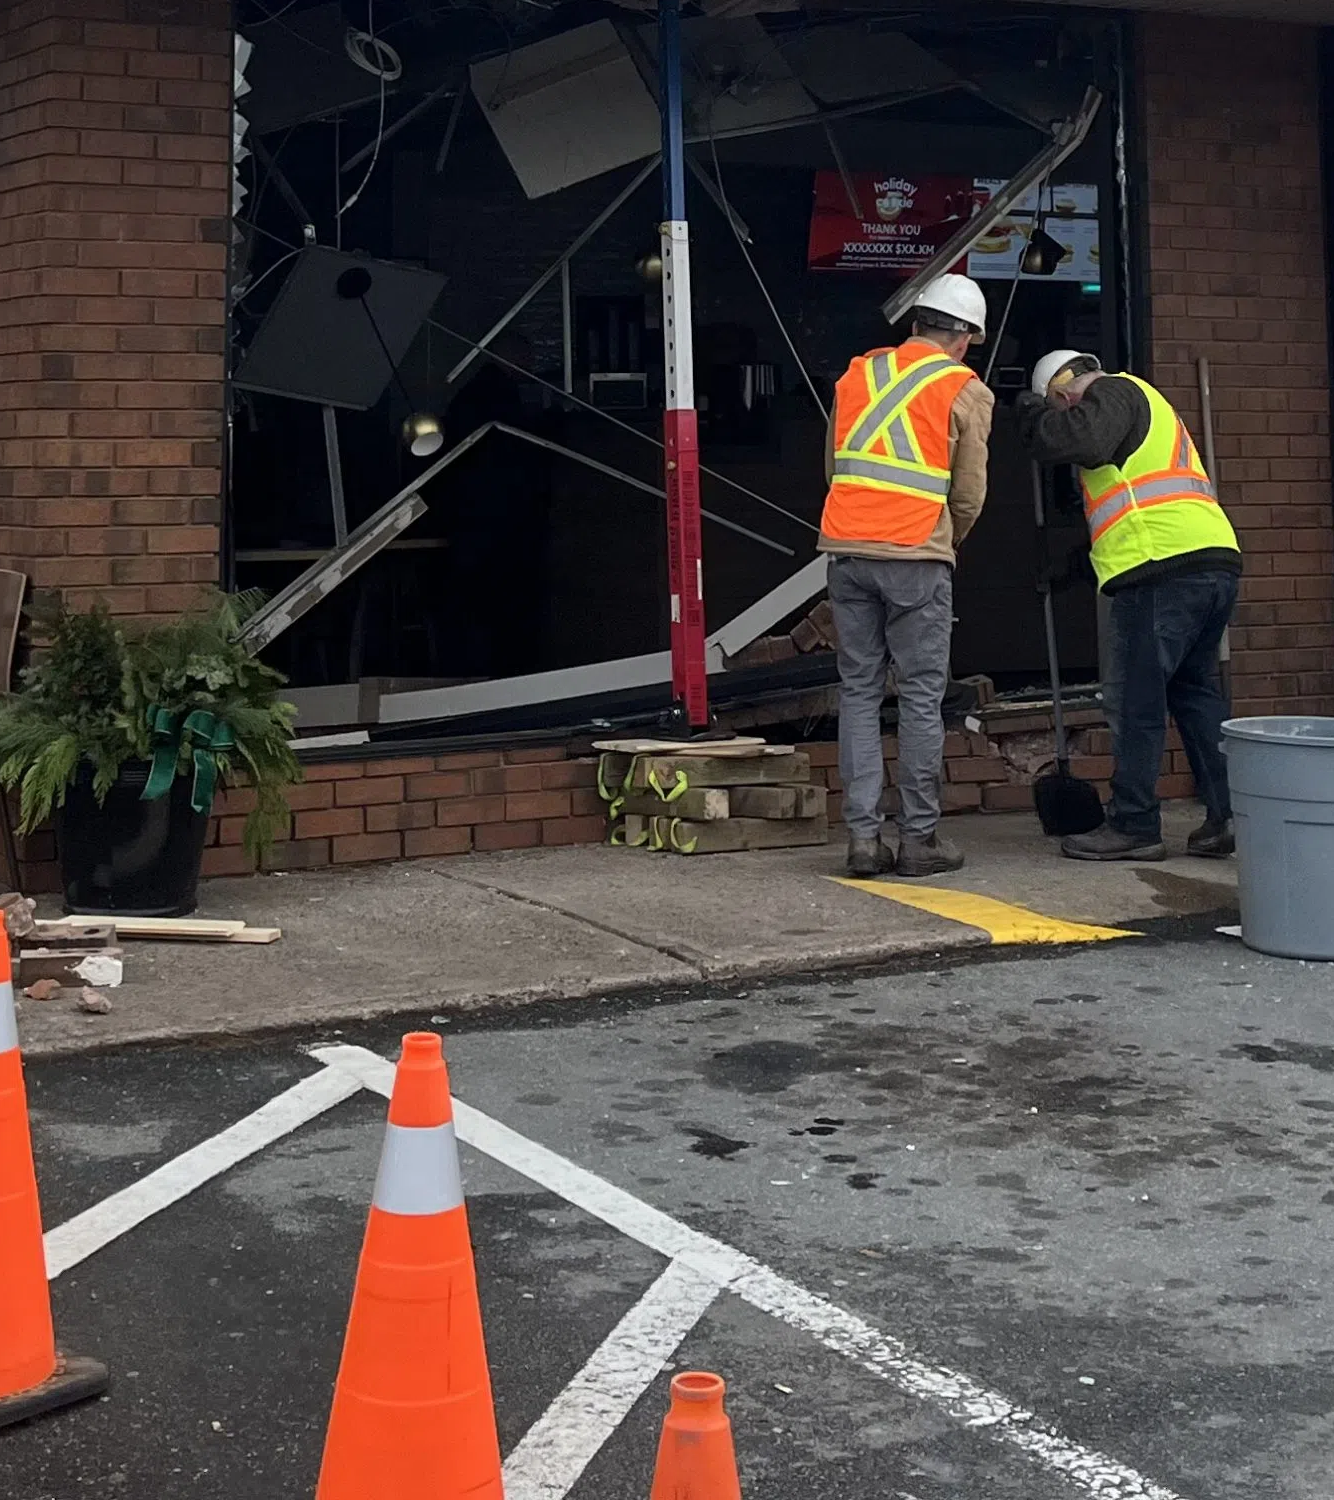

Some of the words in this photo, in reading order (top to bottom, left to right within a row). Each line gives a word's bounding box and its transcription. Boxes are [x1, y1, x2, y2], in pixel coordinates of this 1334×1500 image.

[873, 177, 918, 197] holiday
[861, 223, 897, 235] THANK
[899, 225, 921, 236] YOU
